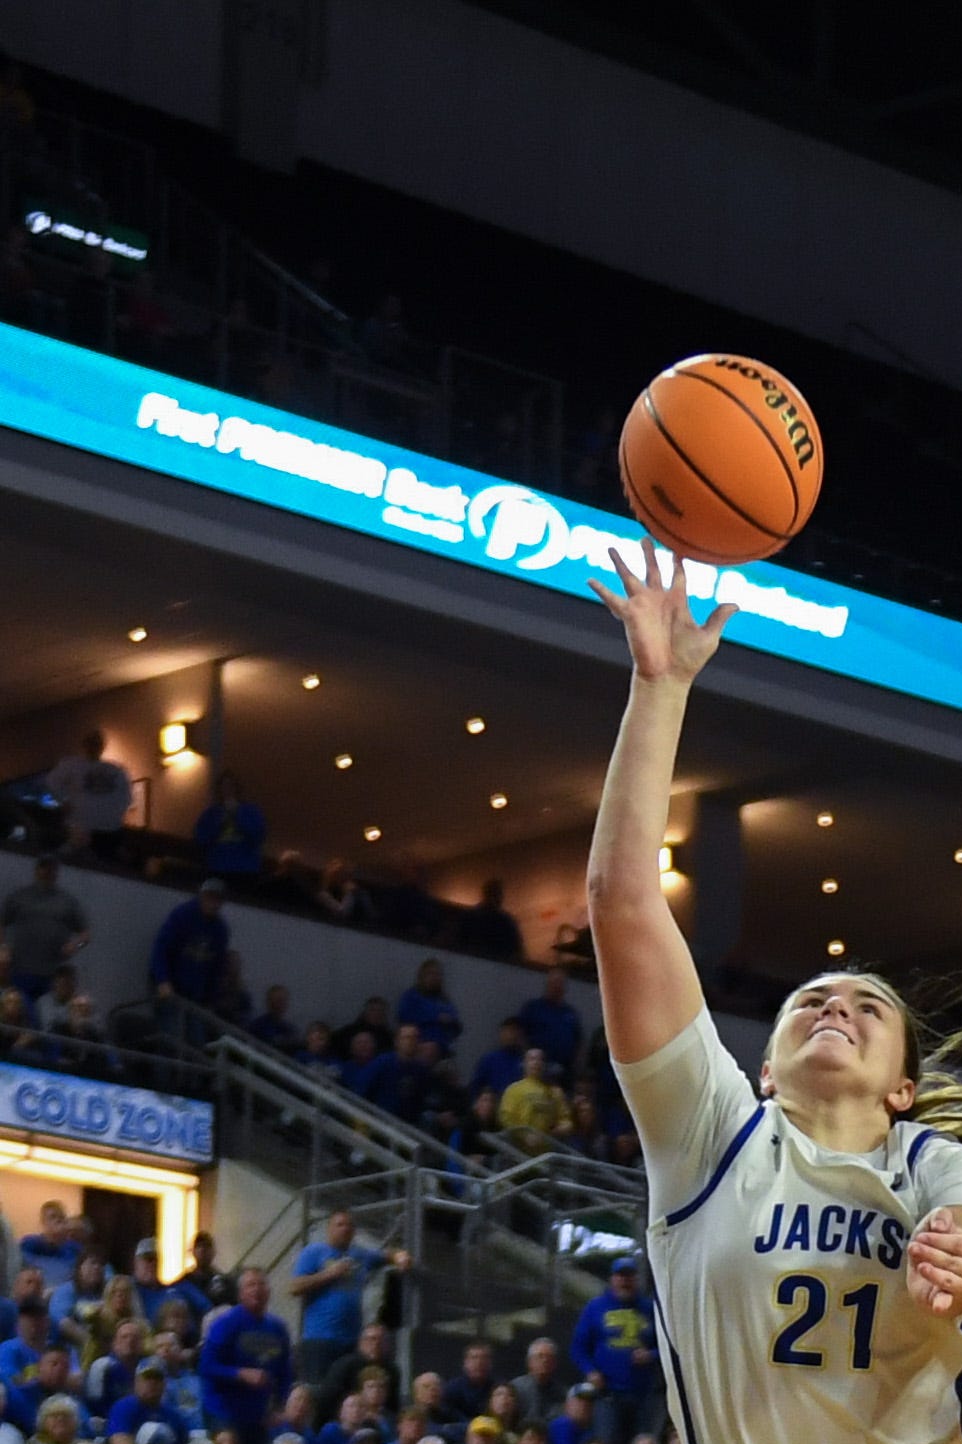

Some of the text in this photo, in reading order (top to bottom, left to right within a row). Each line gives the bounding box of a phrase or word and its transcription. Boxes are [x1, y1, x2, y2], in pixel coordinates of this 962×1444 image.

[714, 358, 815, 470] Wilson
[15, 1082, 211, 1155] COLD ZONE
[754, 1203, 905, 1270] JACKS
[770, 1270, 884, 1372] 21
